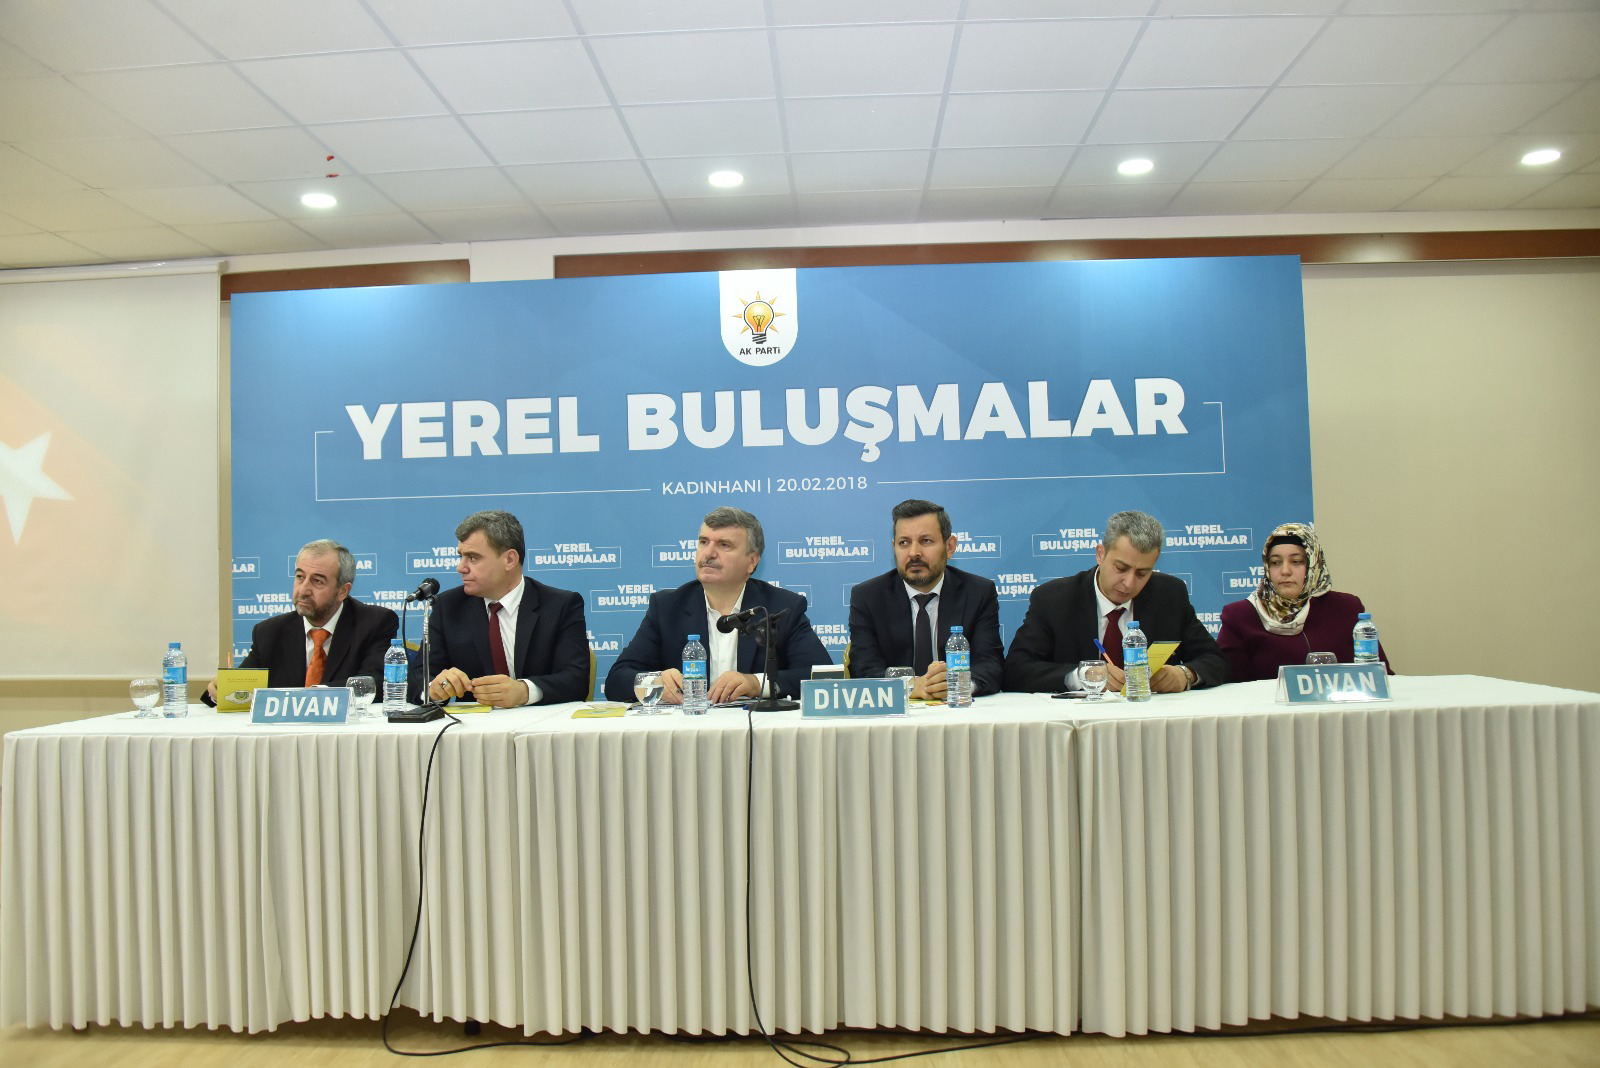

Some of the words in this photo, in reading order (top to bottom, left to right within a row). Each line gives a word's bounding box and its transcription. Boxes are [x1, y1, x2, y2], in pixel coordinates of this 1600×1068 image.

[739, 347, 752, 355] AK
[345, 396, 600, 460] YEREL
[626, 378, 1188, 463] BULUŞMALAR
[662, 479, 761, 495] KADINHANI
[776, 476, 868, 492] 20.02.2018
[1059, 528, 1099, 539] YEREL
[1185, 524, 1224, 534] YEREL
[805, 535, 845, 546] YEREL
[1166, 535, 1248, 548] BULUŞMALAR
[554, 543, 593, 553] YEREL
[786, 546, 869, 560] BULUŞMALAR
[535, 553, 617, 567] BULUŞMALAR
[997, 573, 1038, 583] YEREL
[617, 584, 657, 594] YEREL
[256, 593, 293, 603] YEREL
[814, 683, 894, 710] DİVAN
[264, 692, 340, 717] DİVAN
